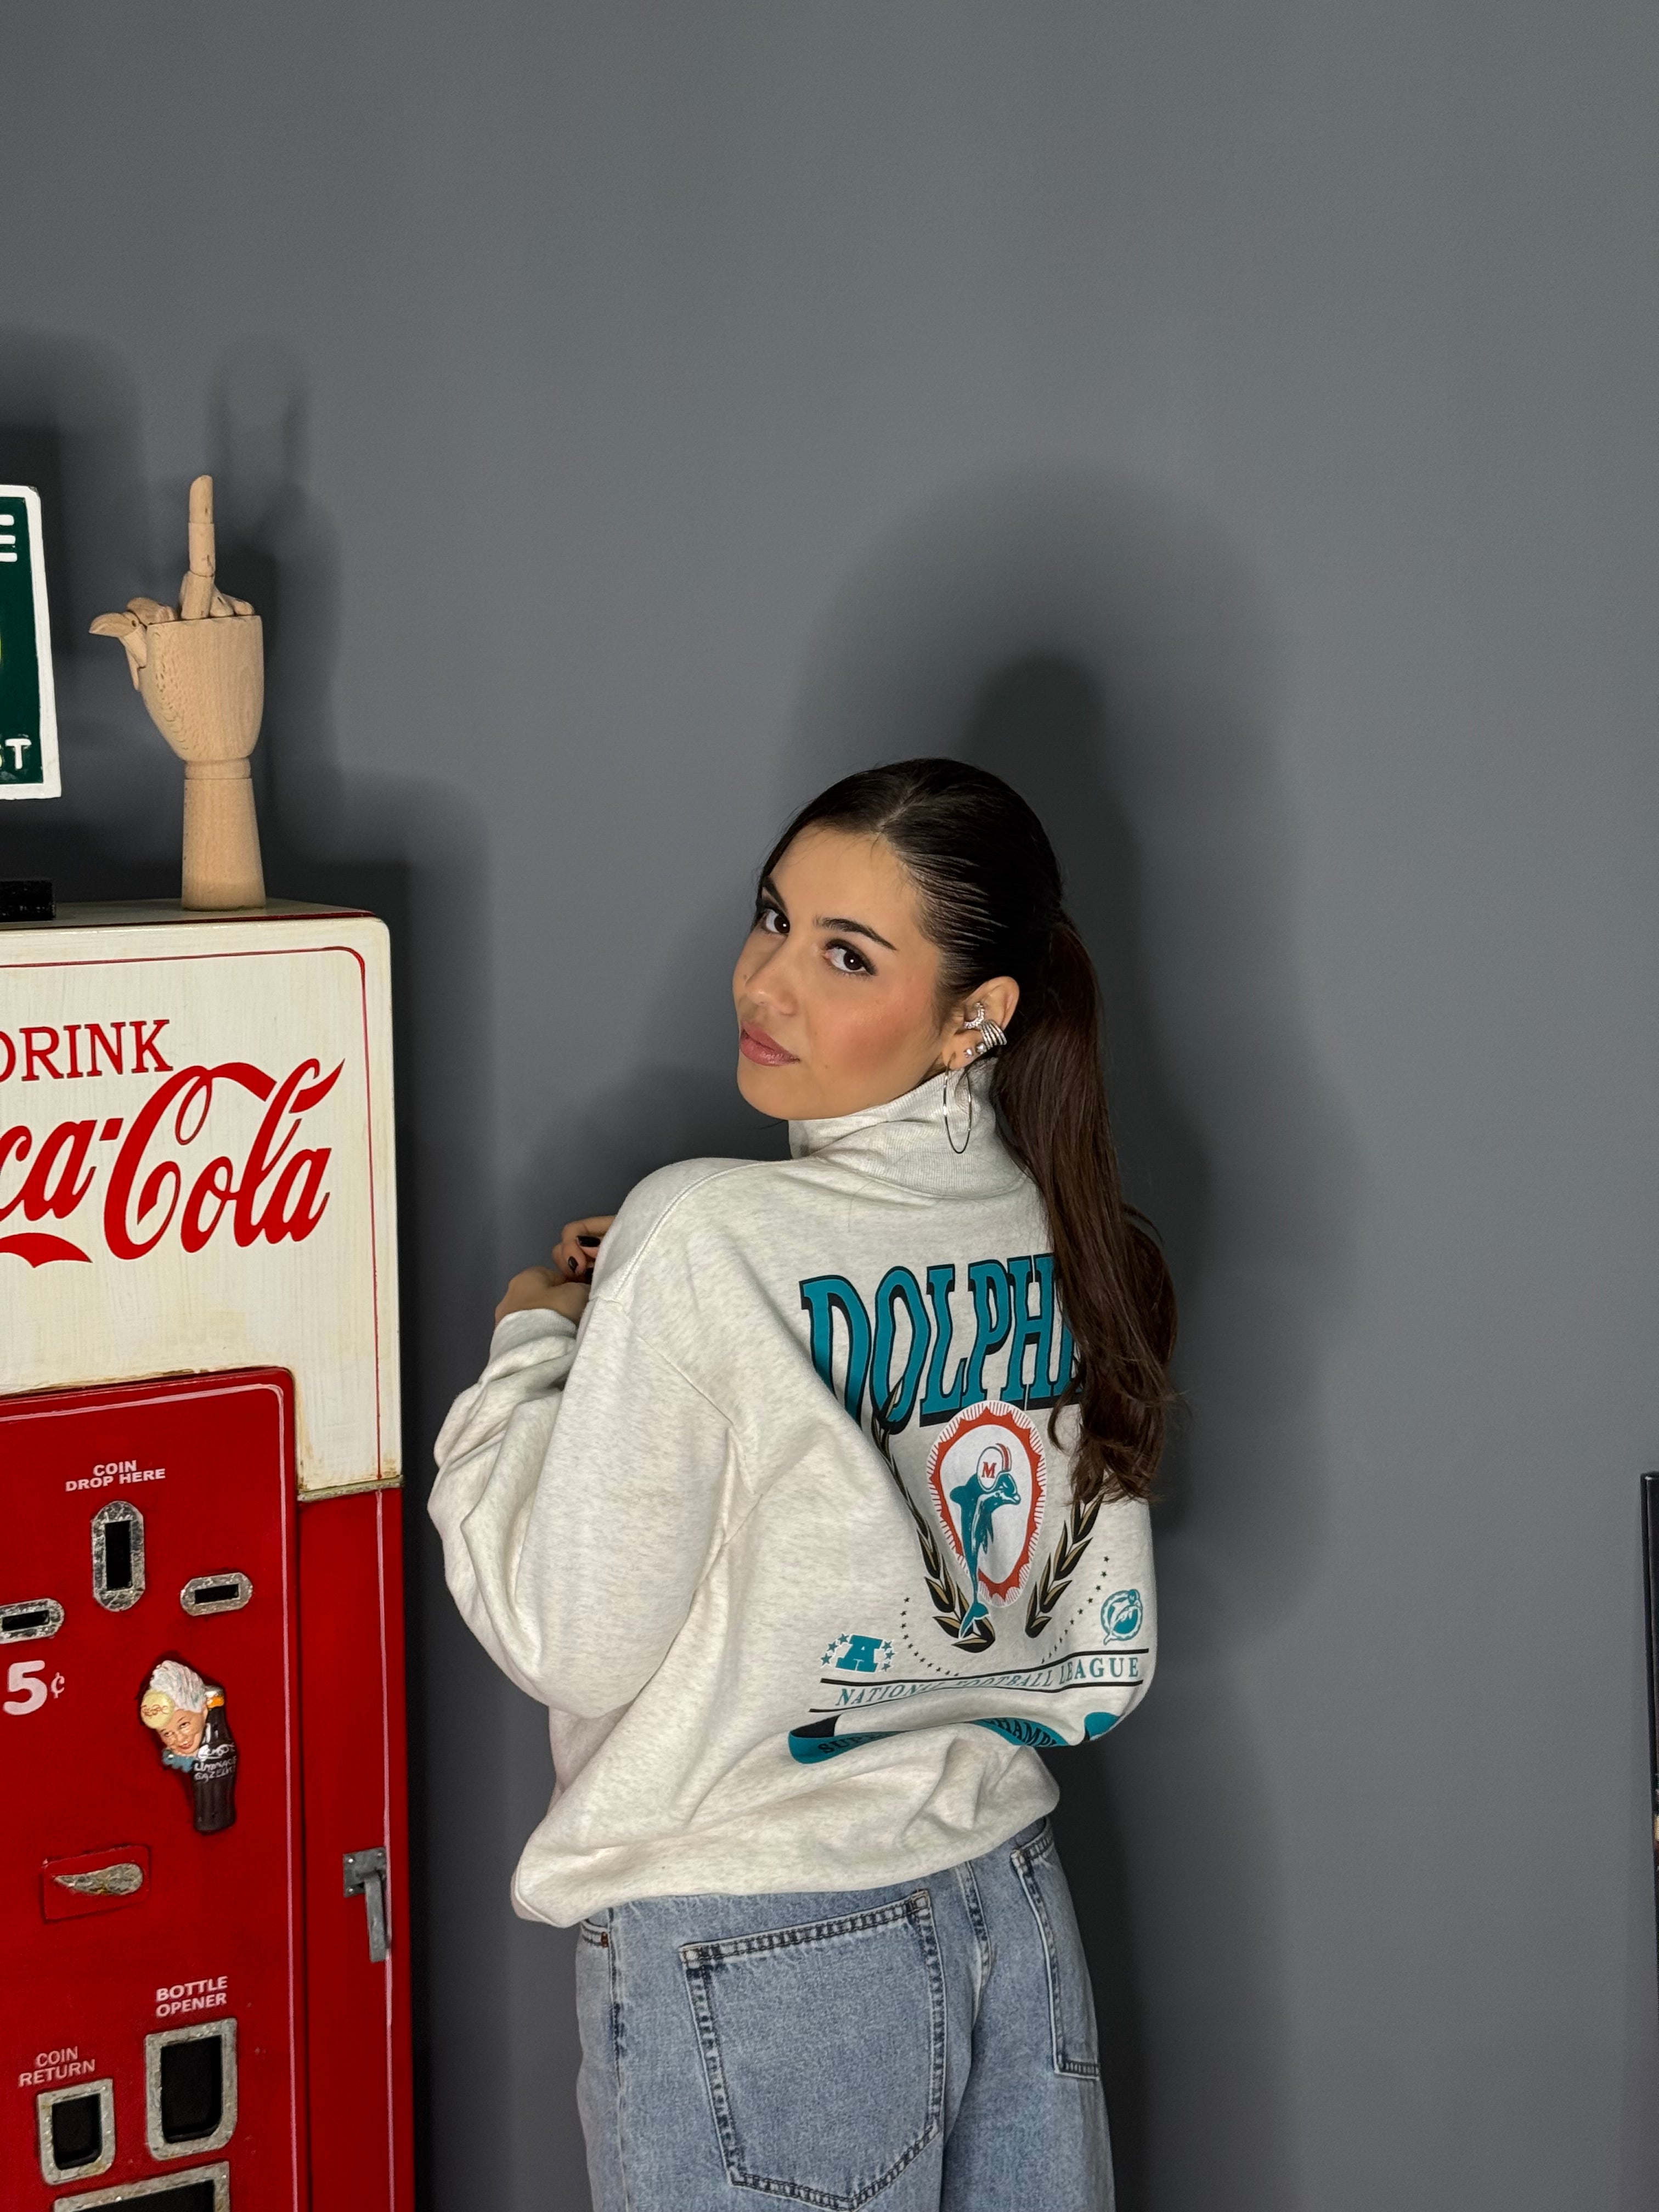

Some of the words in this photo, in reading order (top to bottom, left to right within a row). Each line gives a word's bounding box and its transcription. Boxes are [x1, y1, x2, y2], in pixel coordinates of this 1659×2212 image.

[65, 1475, 114, 1492] DROP
[119, 1468, 166, 1485] HERE
[93, 1459, 137, 1477] COIN
[981, 1461, 997, 1479] M
[834, 1634, 884, 1673] A
[1059, 1657, 1139, 1685] LEAGUE
[156, 1976, 228, 2002] BOTTLE
[156, 1992, 227, 2018] OPENER
[35, 2046, 79, 2068] COIN
[18, 2058, 95, 2088] RETURN
